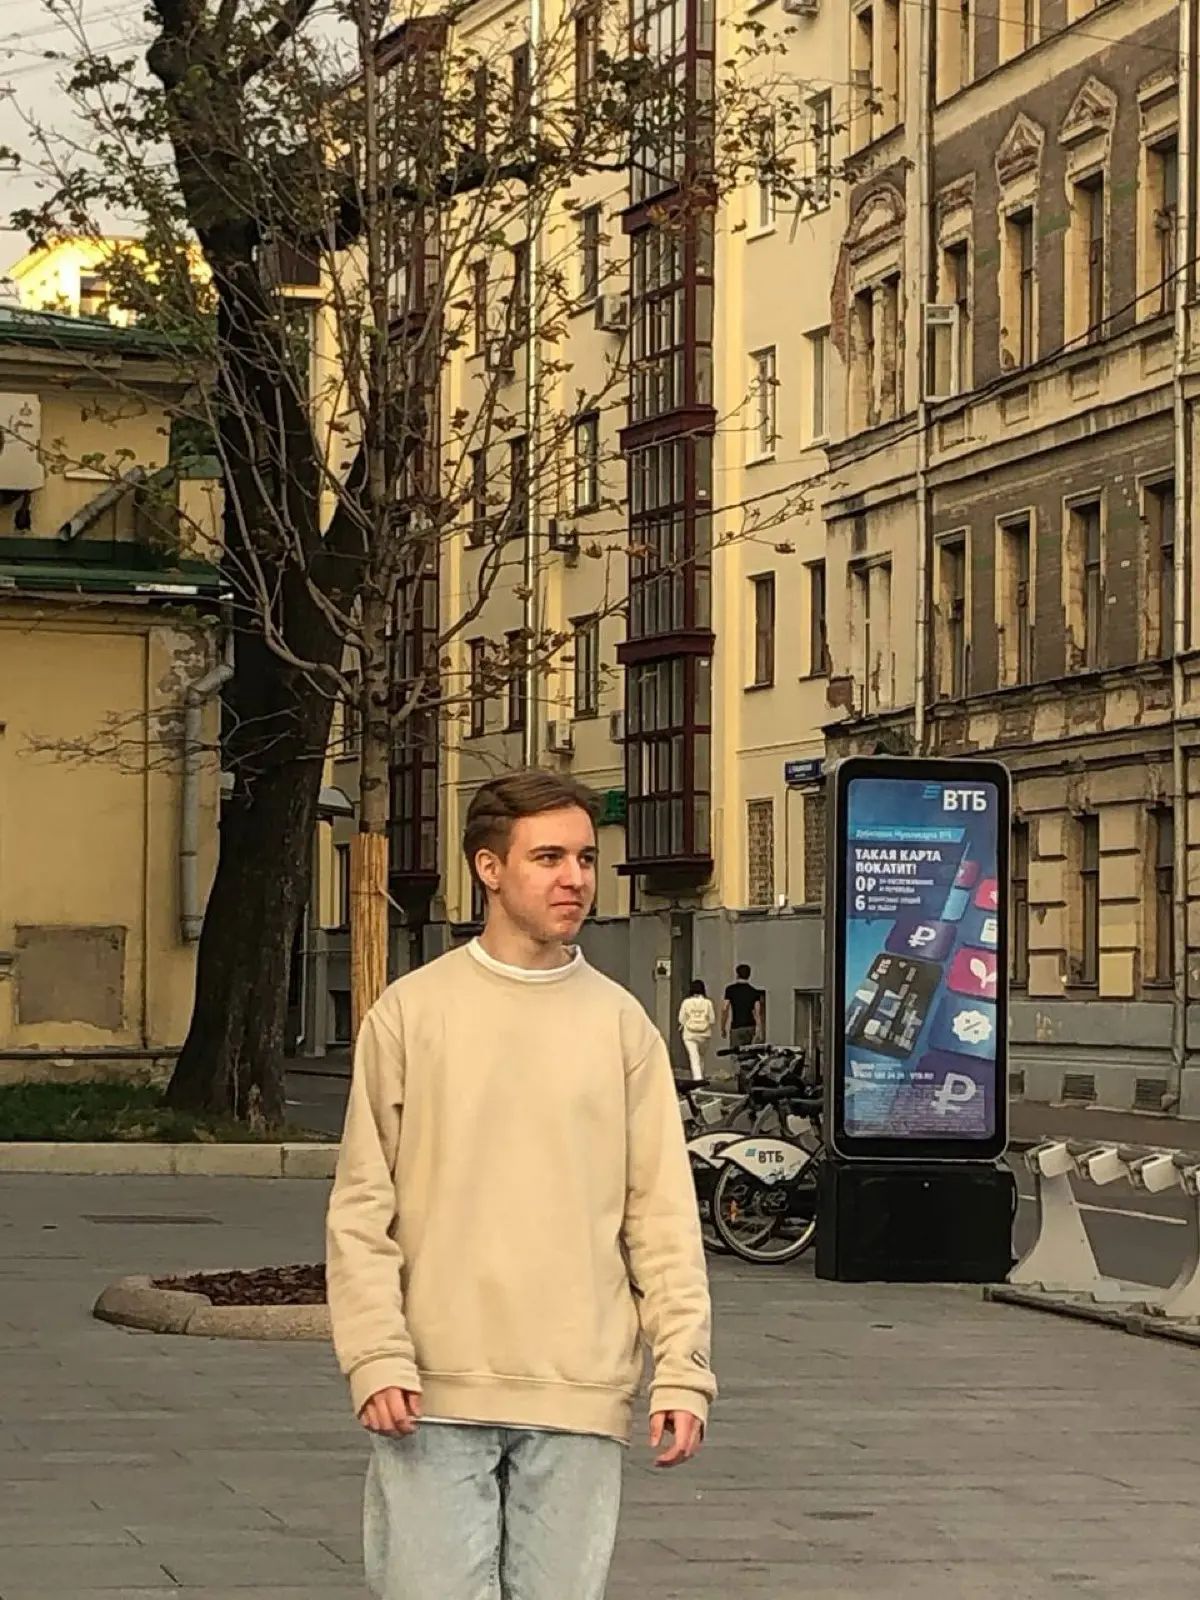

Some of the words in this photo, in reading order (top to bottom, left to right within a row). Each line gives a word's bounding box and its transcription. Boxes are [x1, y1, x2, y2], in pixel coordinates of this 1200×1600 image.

[943, 789, 987, 811] ВТБ
[855, 849, 897, 861] ТАКАЯ
[900, 849, 942, 862] КАРТА
[855, 862, 917, 875] ПОКАТИТ!
[758, 1150, 784, 1164] ВТБ
